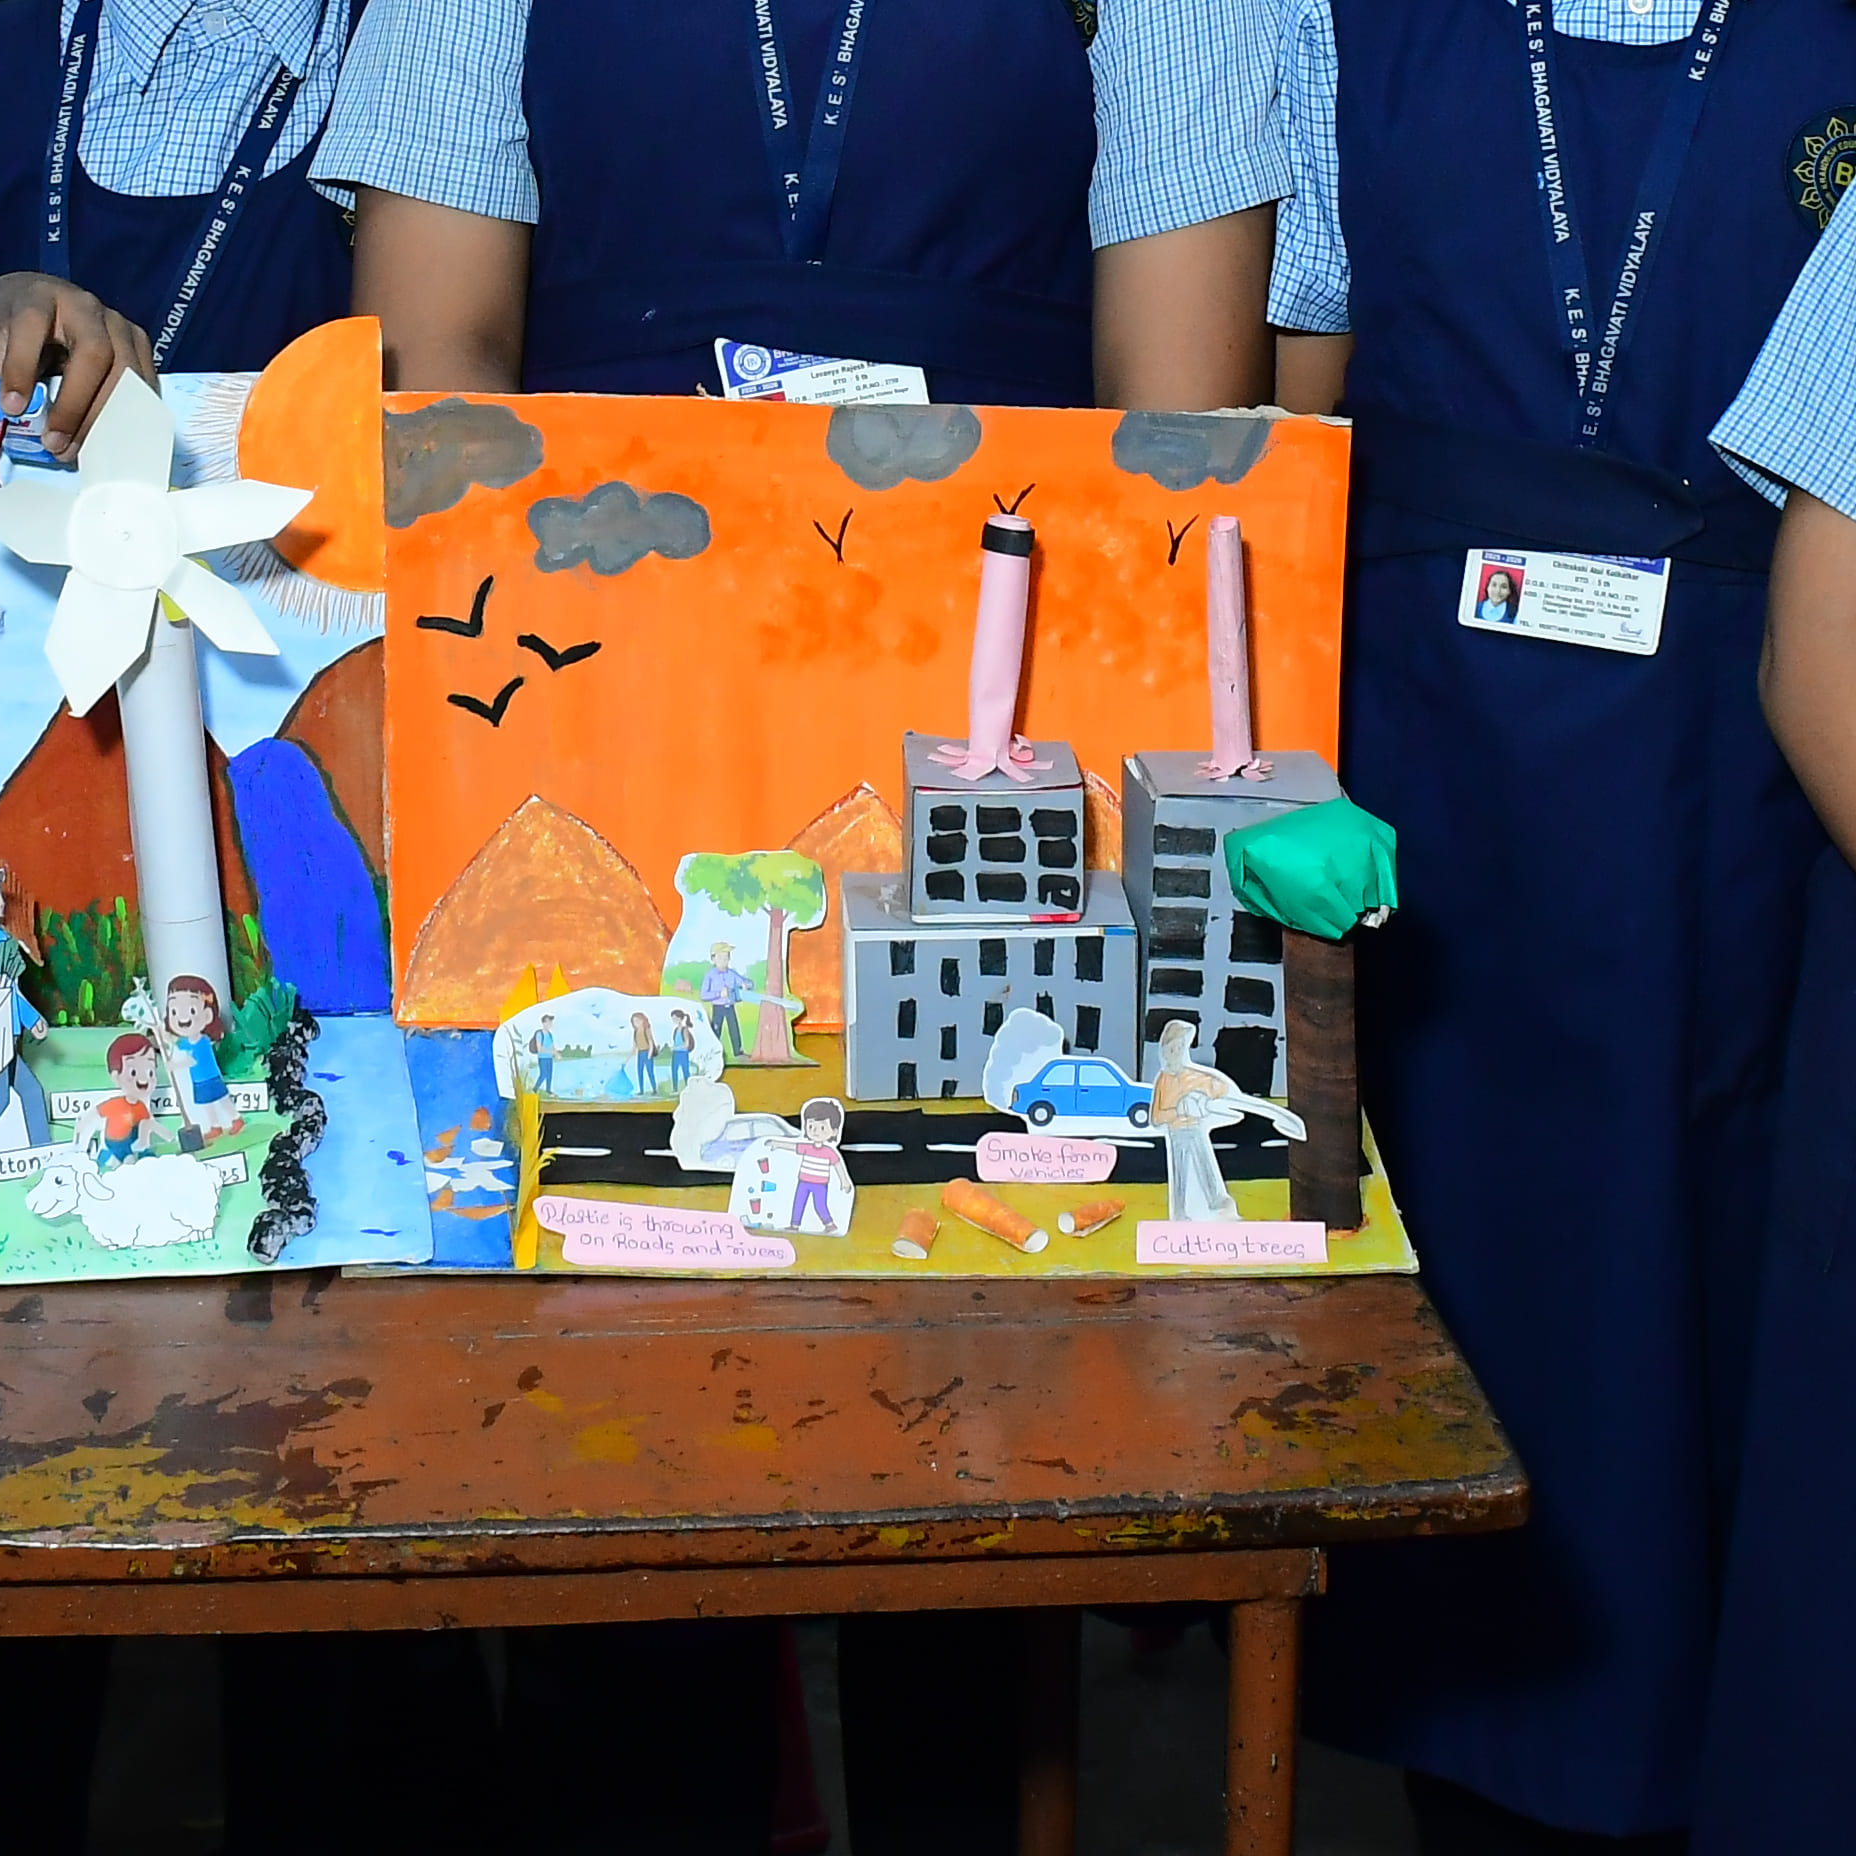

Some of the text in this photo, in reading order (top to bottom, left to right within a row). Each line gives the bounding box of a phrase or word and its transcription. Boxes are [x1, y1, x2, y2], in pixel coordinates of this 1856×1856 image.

[761, 41, 788, 129] VIDYALAYA
[50, 33, 86, 185] BHAGAVATI VIDYALAYA
[1531, 61, 1570, 243] BHAGAVATI VIDYALAYA
[987, 1138, 1052, 1164] Smoke
[541, 1202, 734, 1239] Plastic is throwing
[682, 1240, 722, 1256] and
[726, 1242, 784, 1259] rivers
[1152, 1232, 1306, 1260] Cutting trees
